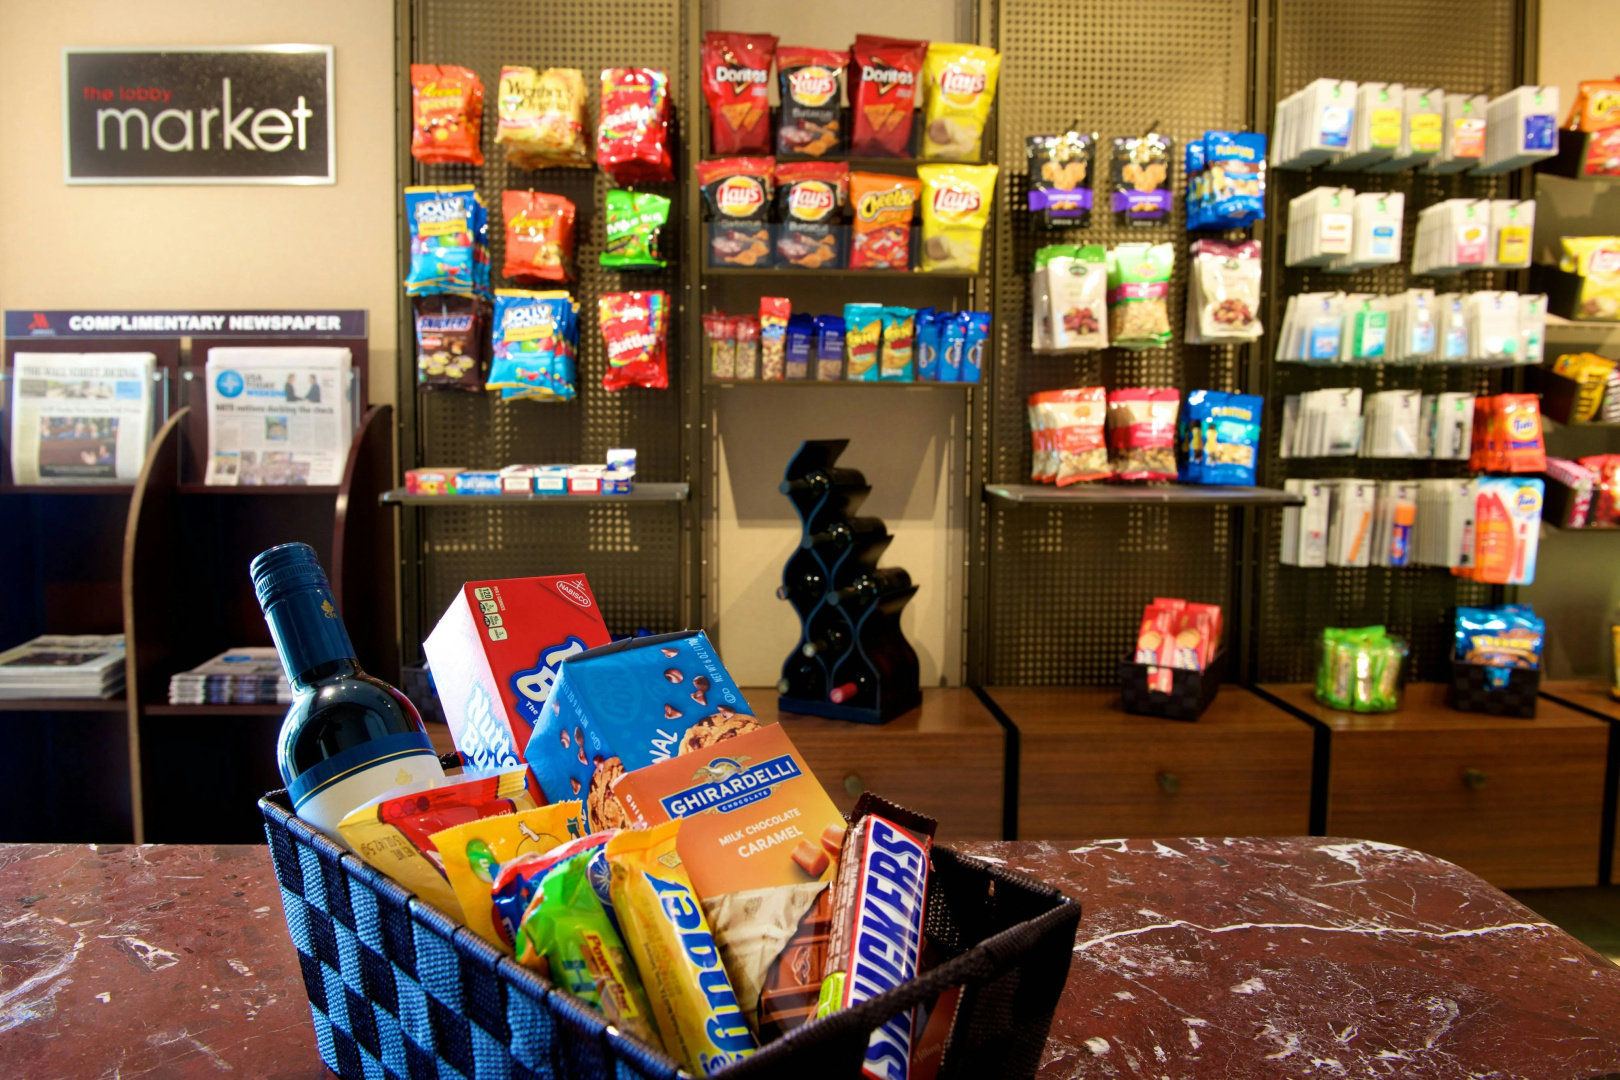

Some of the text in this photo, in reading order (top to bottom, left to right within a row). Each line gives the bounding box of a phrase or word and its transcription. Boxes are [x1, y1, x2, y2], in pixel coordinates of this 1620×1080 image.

[716, 66, 767, 84] Doritos
[862, 66, 913, 84] Doritos
[84, 87, 173, 103] the lobby
[97, 77, 313, 152] market
[69, 315, 341, 331] COMPLIMENTARY NEWSPAPER
[1513, 419, 1534, 431] Tide
[1518, 494, 1537, 506] Tide
[483, 588, 491, 599] 120
[559, 582, 589, 605] NABISCO
[711, 672, 724, 683] NET
[525, 701, 539, 715] The
[467, 686, 518, 768] Nutte
[649, 728, 678, 764] NAL
[670, 761, 796, 815] GHIRARDELLI
[625, 794, 649, 829] GHIRA
[721, 790, 769, 812] CHOCOLATE
[718, 807, 801, 846] MILK CHOCOLATE
[737, 825, 803, 858] CARAMEL
[641, 871, 755, 1052] finger
[853, 820, 927, 1080] SNICKERS
[585, 934, 633, 1011] PowerBar
